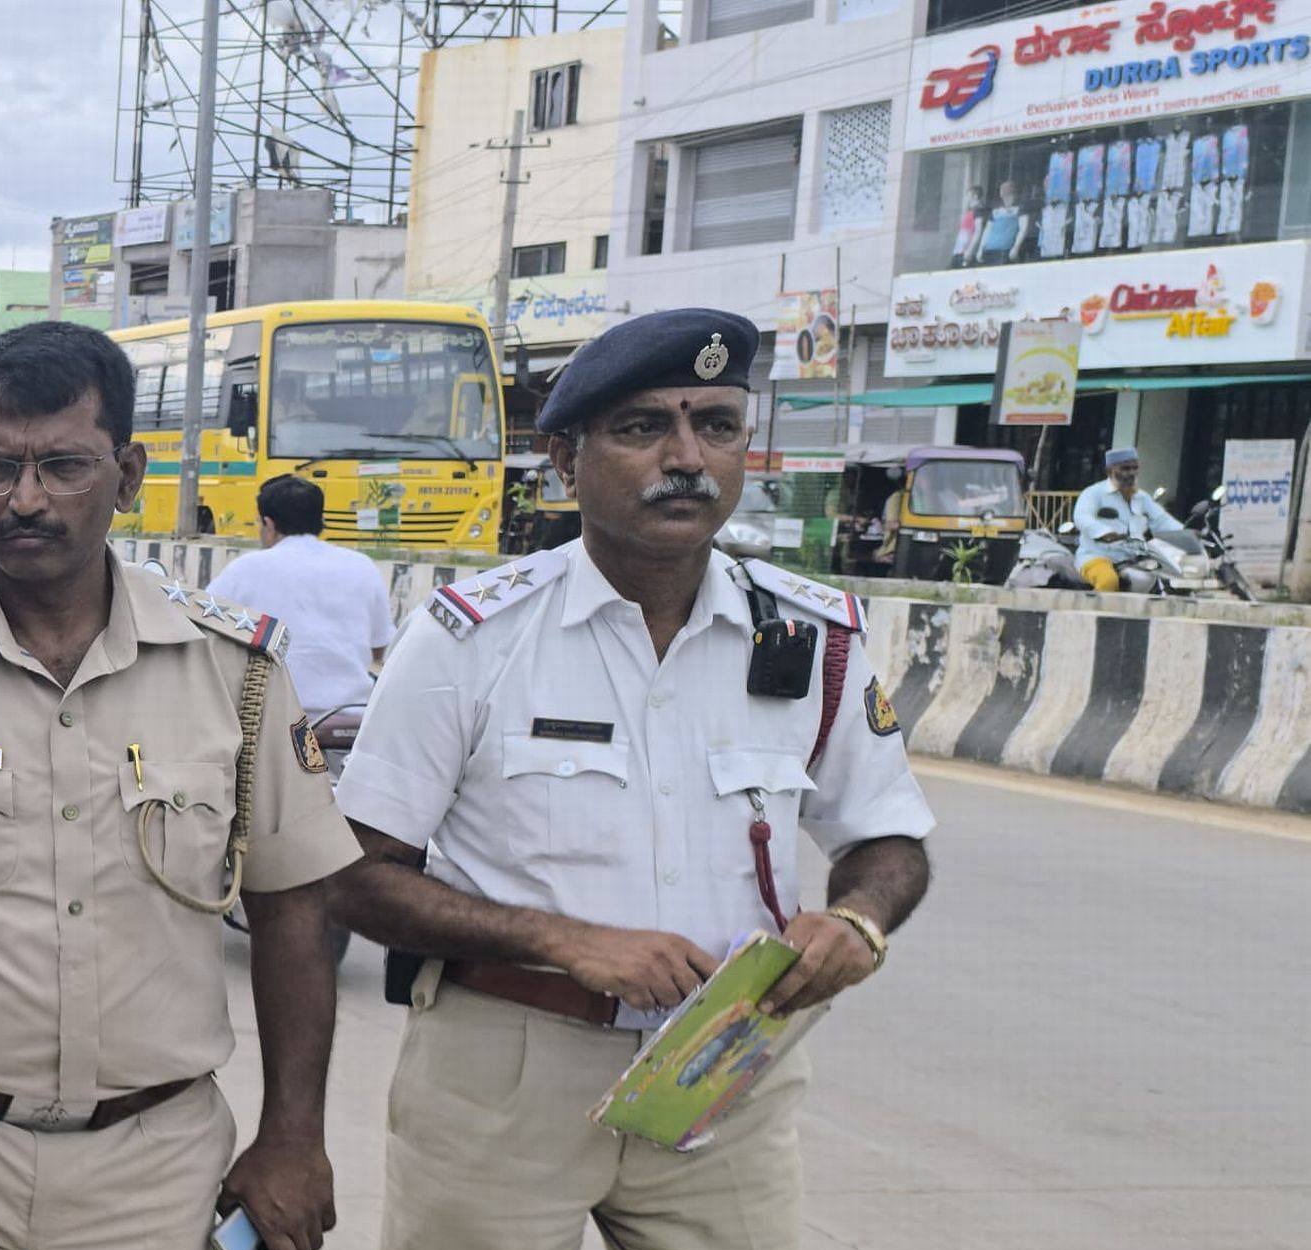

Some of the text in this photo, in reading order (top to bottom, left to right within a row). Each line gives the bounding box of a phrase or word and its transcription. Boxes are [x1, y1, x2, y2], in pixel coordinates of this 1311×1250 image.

[1085, 34, 1311, 92] DURGA SPORTS
[1002, 121, 1021, 135] ALL
[1052, 115, 1065, 128] OF
[1066, 110, 1106, 126] SPORTS
[1198, 90, 1247, 108] PRINTING
[1248, 84, 1282, 101] HERE
[1026, 86, 1160, 117] Exclusive Sports Wears
[1110, 283, 1199, 314] Chicken
[1165, 308, 1237, 338] Affair
